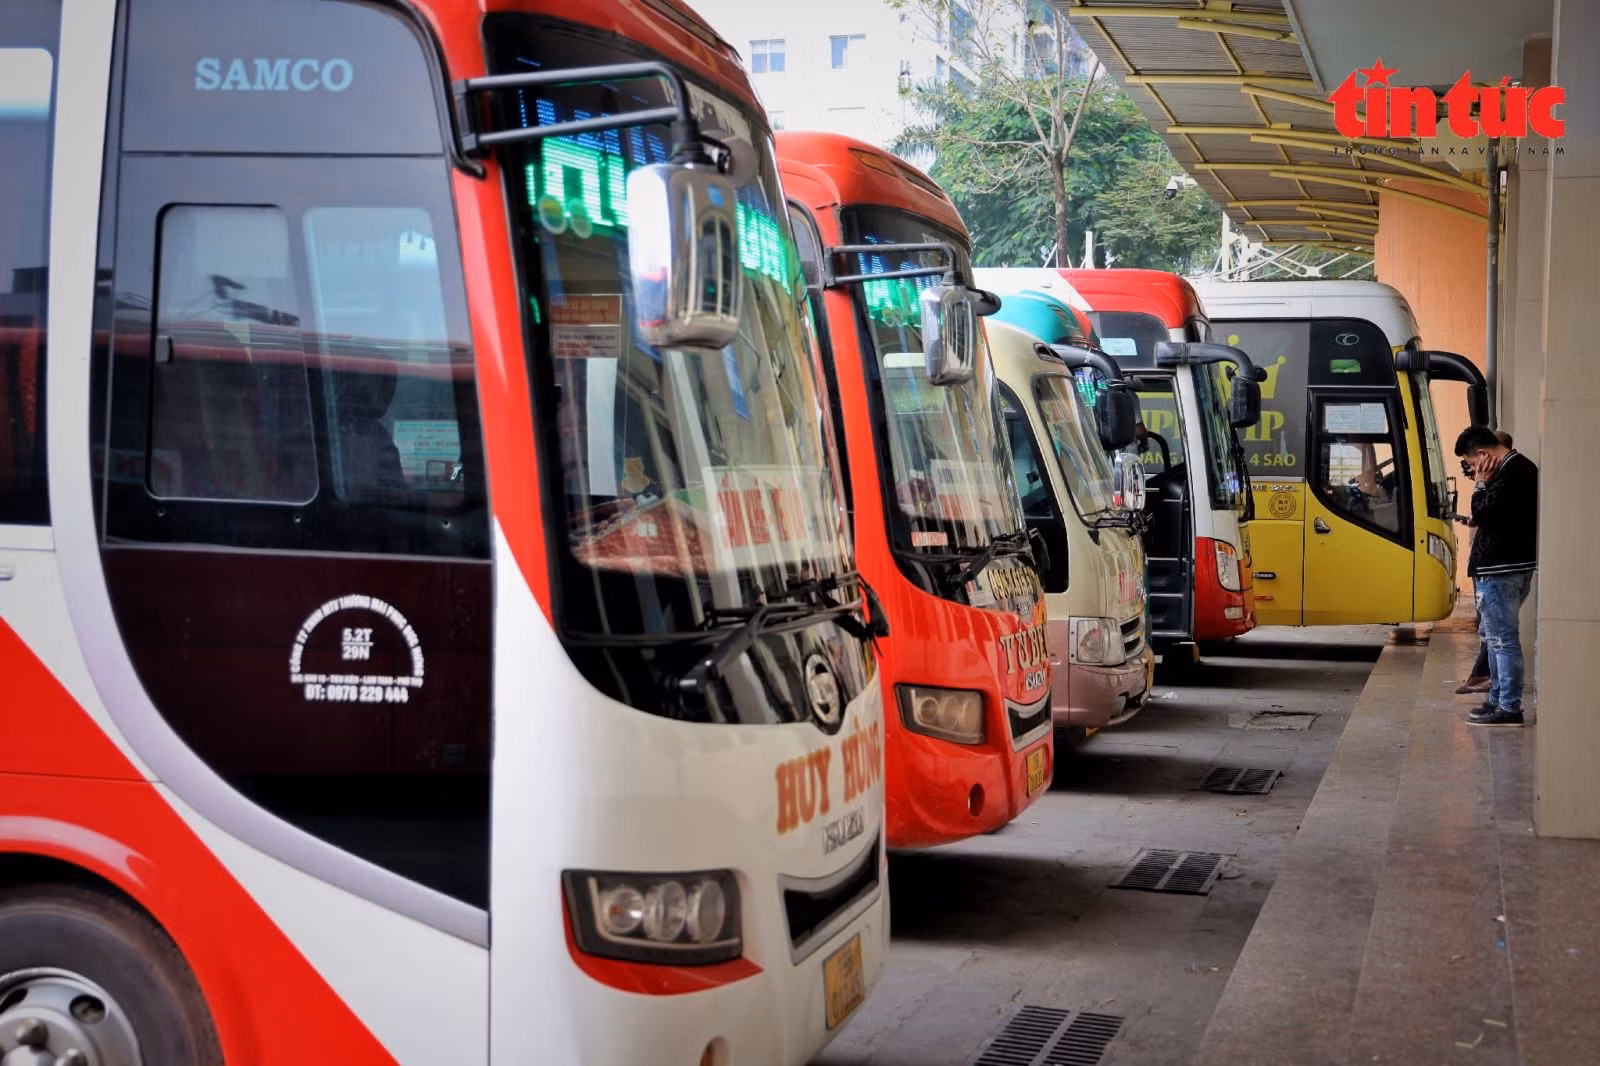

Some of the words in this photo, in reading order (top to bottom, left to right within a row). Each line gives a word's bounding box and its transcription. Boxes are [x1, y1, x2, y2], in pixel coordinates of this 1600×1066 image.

[195, 58, 353, 92] SAMCO
[1250, 453, 1260, 467] 4
[1263, 453, 1297, 467] SAO
[342, 628, 374, 643] 5.2T
[341, 645, 371, 661] 29N
[775, 747, 831, 833] HUY
